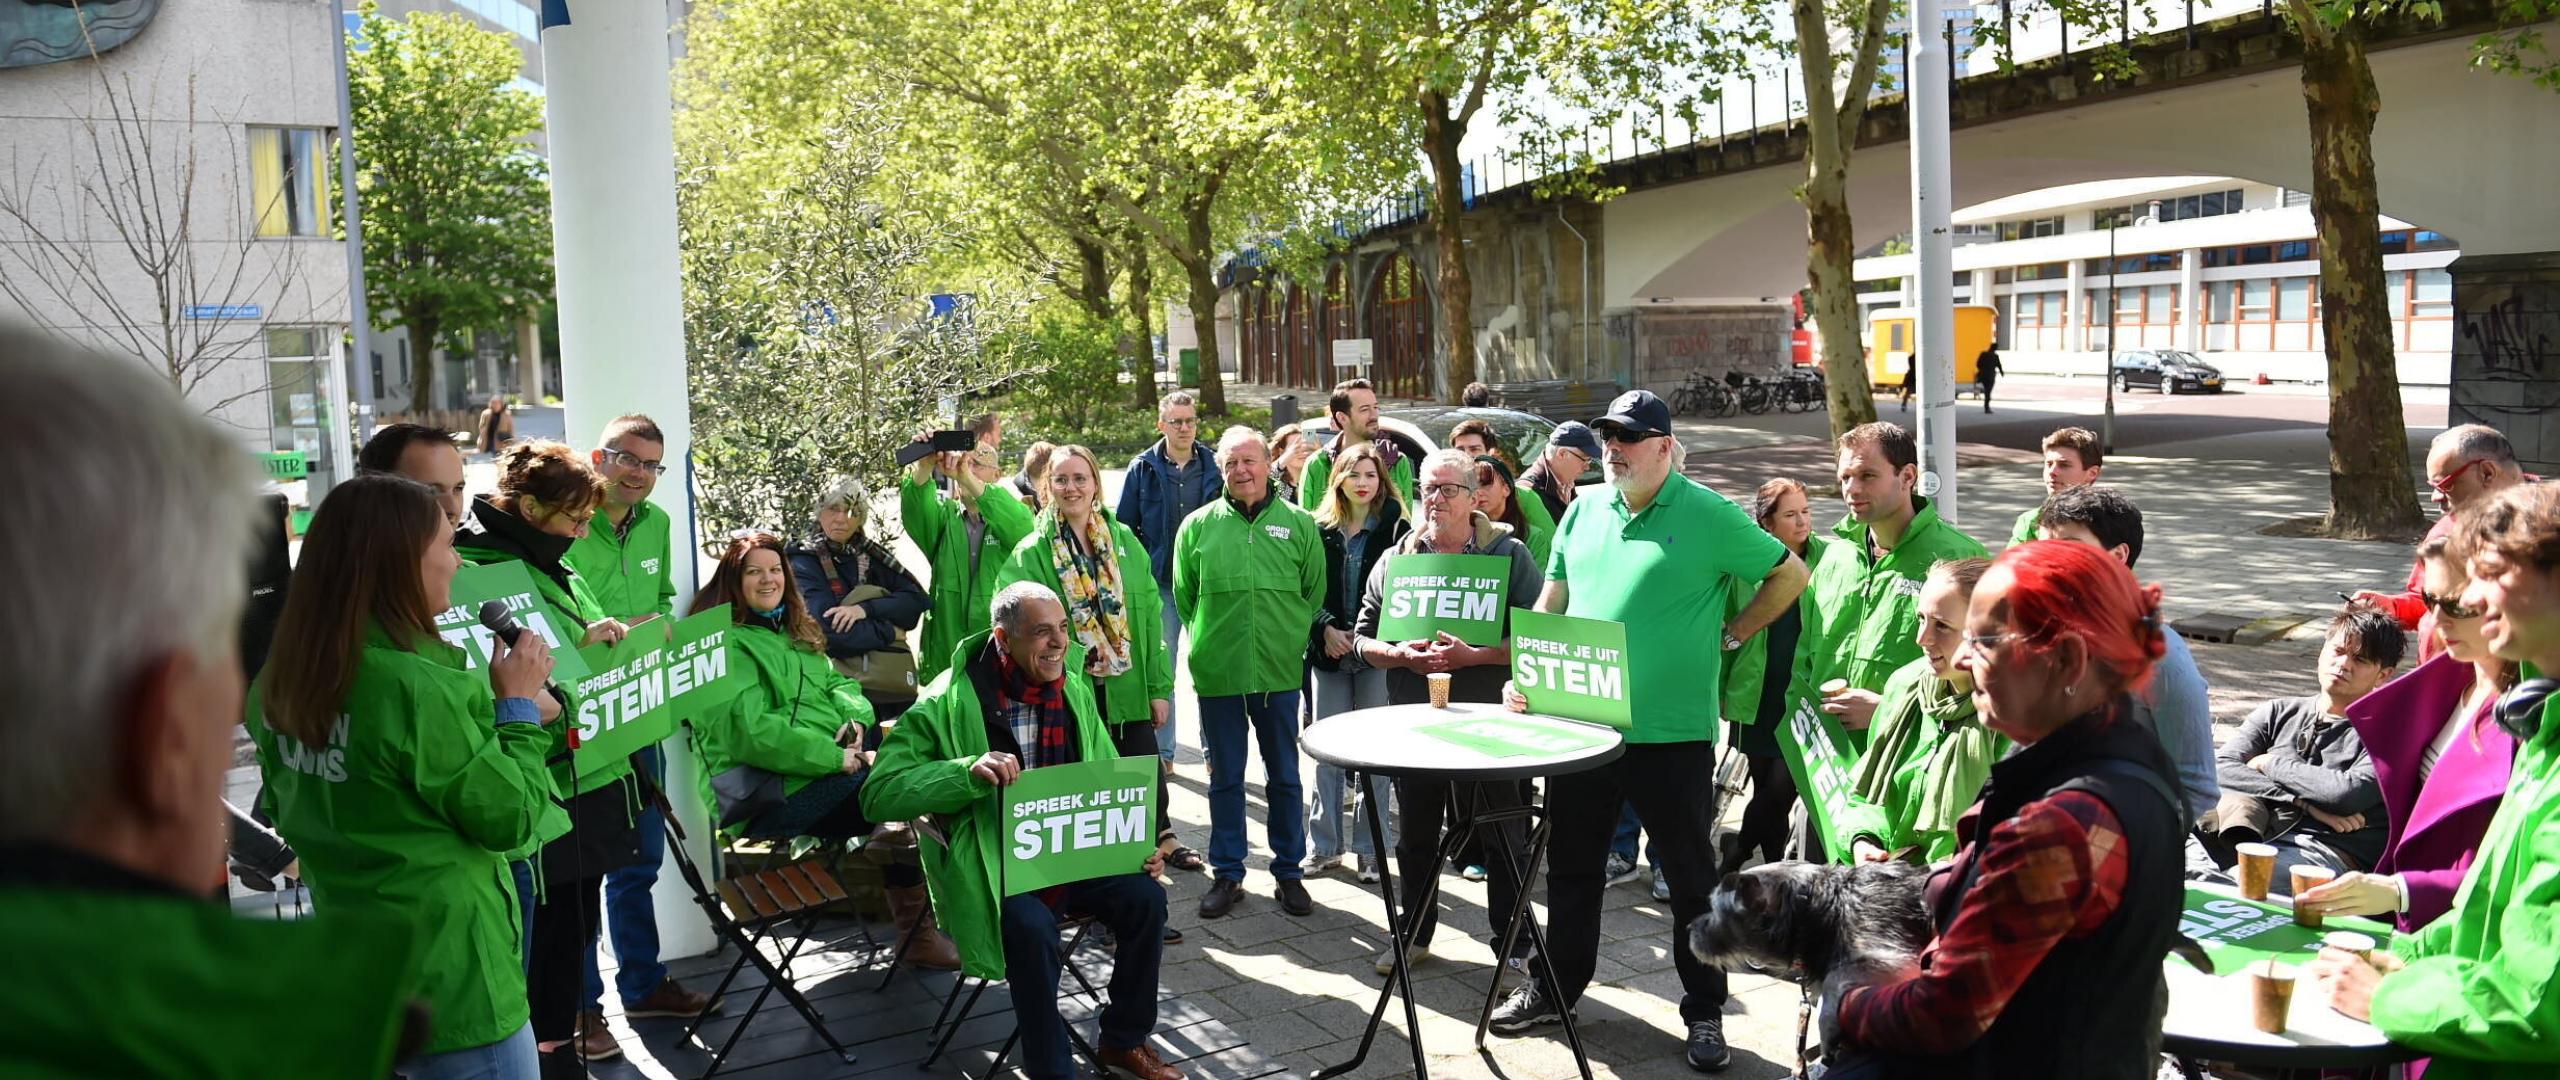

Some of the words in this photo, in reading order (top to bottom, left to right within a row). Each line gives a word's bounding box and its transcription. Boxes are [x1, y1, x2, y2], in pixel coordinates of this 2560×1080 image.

[1392, 575, 1448, 588] SPREEK
[1451, 576, 1470, 588] JE
[1474, 578, 1500, 590] UIT
[1388, 589, 1498, 622] STEM
[679, 641, 697, 659] JE
[700, 630, 725, 650] UIT
[1516, 635, 1570, 656] SPREEK
[1573, 645, 1592, 659] JE
[1595, 647, 1620, 663] UIT
[577, 664, 627, 698] SPREEK
[629, 657, 642, 676] JE
[643, 648, 662, 669] UIT
[1516, 652, 1623, 701] STEM
[578, 667, 665, 742] STEM
[1013, 793, 1084, 818] SPREEK
[1089, 790, 1112, 806] JE
[1117, 786, 1147, 803] UIT
[1013, 805, 1147, 860] STEM
